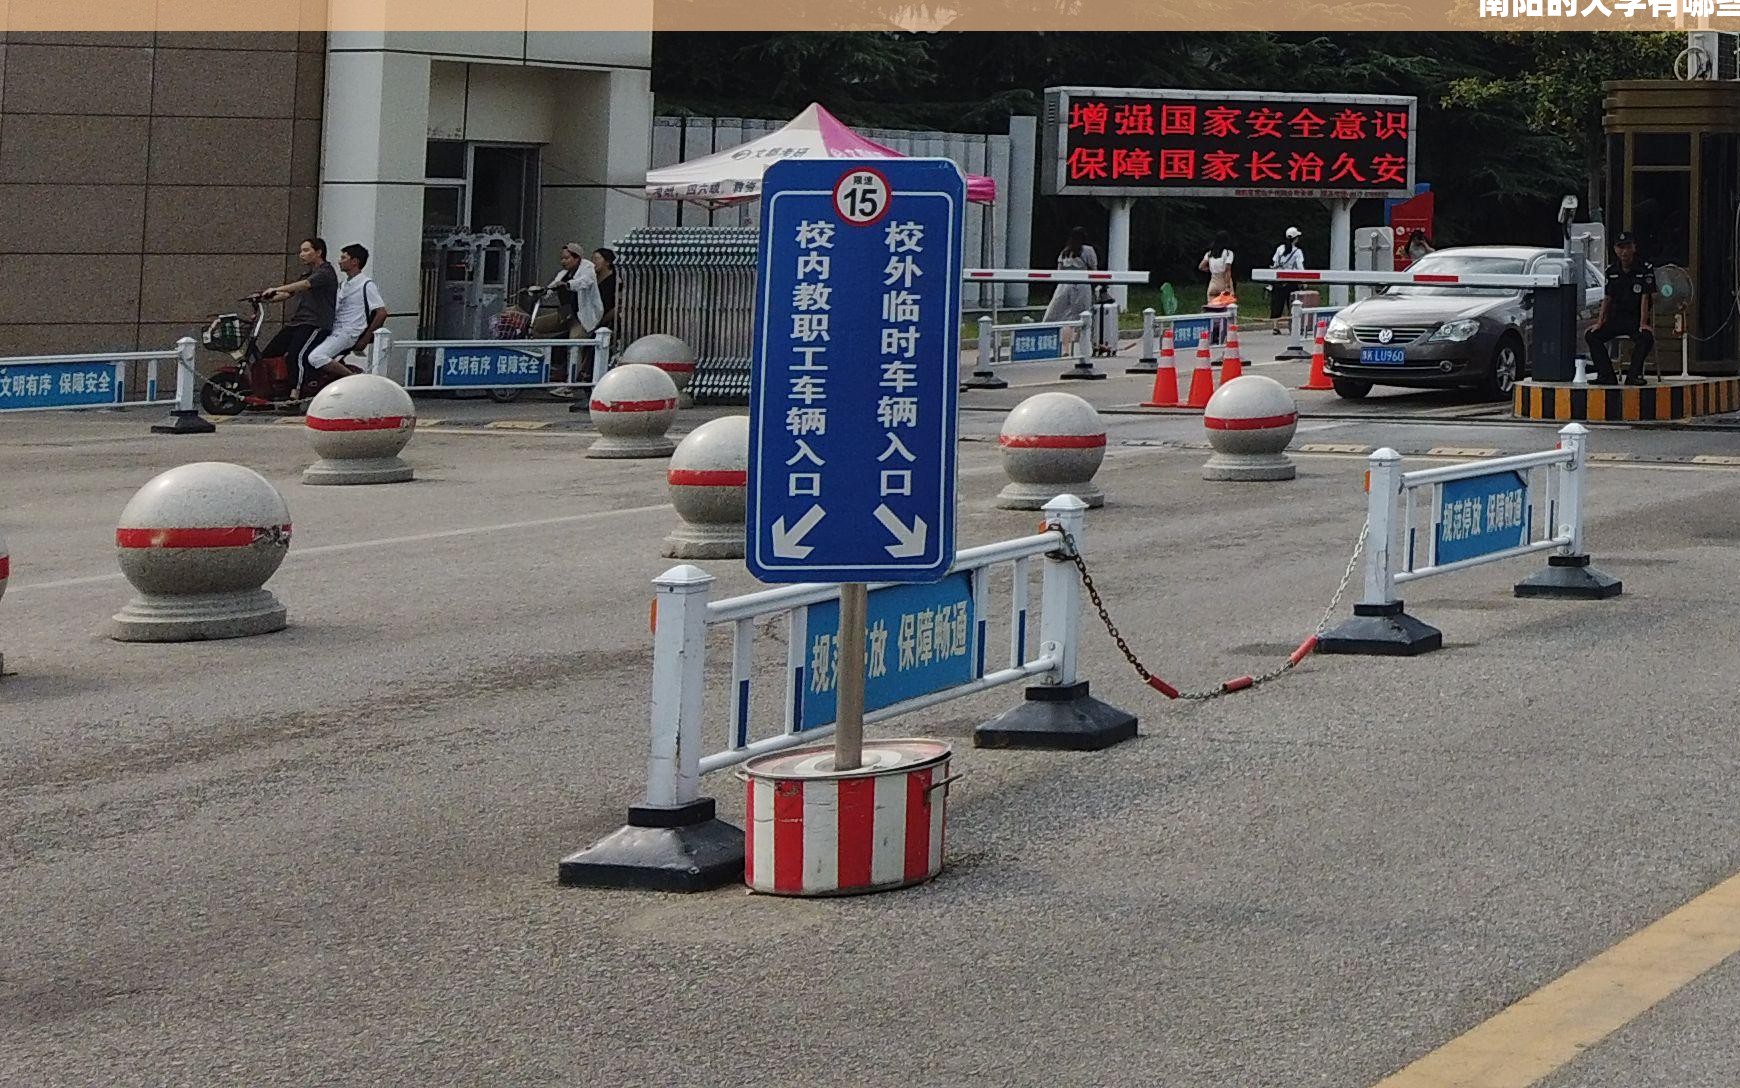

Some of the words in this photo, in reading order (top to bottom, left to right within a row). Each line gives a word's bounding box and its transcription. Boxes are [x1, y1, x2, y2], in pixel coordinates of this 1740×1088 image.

[1068, 103, 1408, 140] 增强国家安全意识
[853, 175, 874, 186] 限速
[1067, 148, 1406, 184] 保障国家长治久安
[843, 188, 878, 217] 15
[447, 355, 492, 375] 文明有序
[497, 354, 540, 375] 保障安全
[785, 220, 836, 498] 校内教职工车辆入口
[876, 221, 925, 497] 校外临时车辆入口
[0, 373, 52, 397] 文明有序
[59, 371, 111, 394] 保障安全
[811, 619, 888, 694] 规放
[898, 600, 969, 671] 保障畅通
